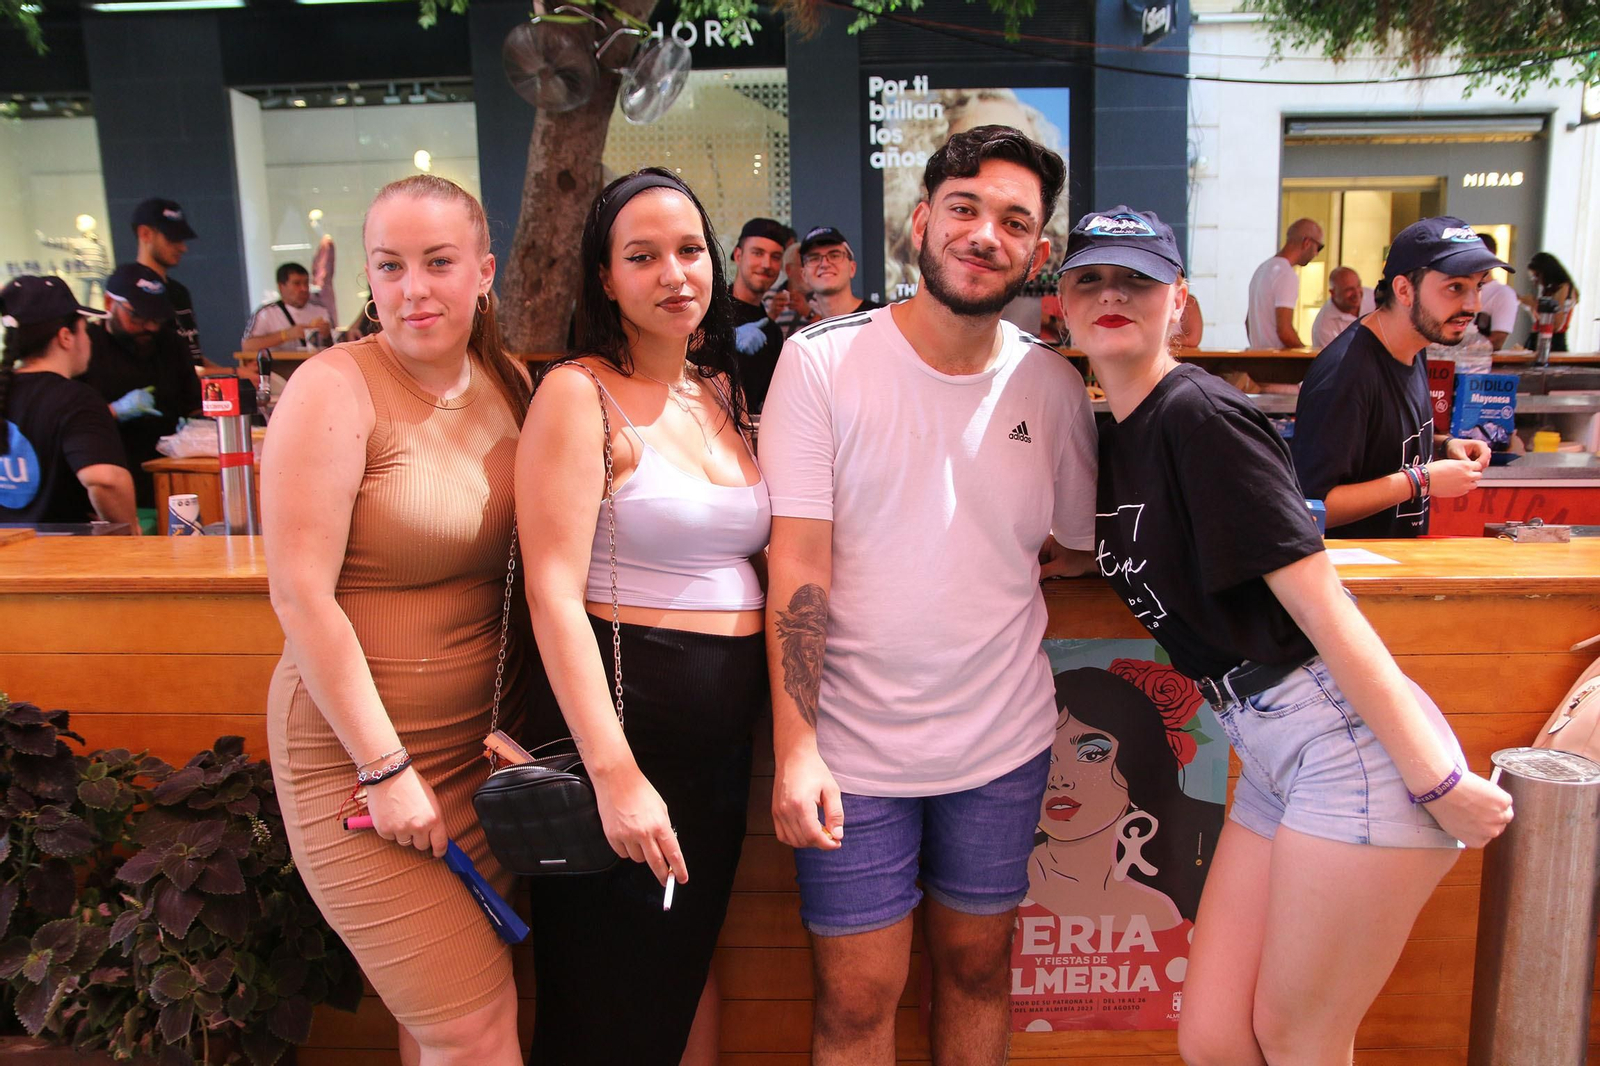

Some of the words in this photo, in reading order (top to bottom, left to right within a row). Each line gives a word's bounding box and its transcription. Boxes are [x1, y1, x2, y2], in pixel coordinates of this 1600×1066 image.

[868, 76, 908, 98] Por
[912, 75, 929, 97] ti
[869, 100, 943, 121] brillan
[869, 124, 903, 145] los
[869, 146, 928, 170] años
[1463, 172, 1524, 188] MIRAS
[1469, 379, 1514, 393] DIDILO
[1471, 393, 1511, 405] Mayonesa
[1009, 432, 1032, 444] adidas
[1012, 914, 1161, 956] ERIA
[1034, 957, 1042, 966] Y
[1044, 956, 1091, 966] FIESTAS
[1093, 955, 1108, 964] DE
